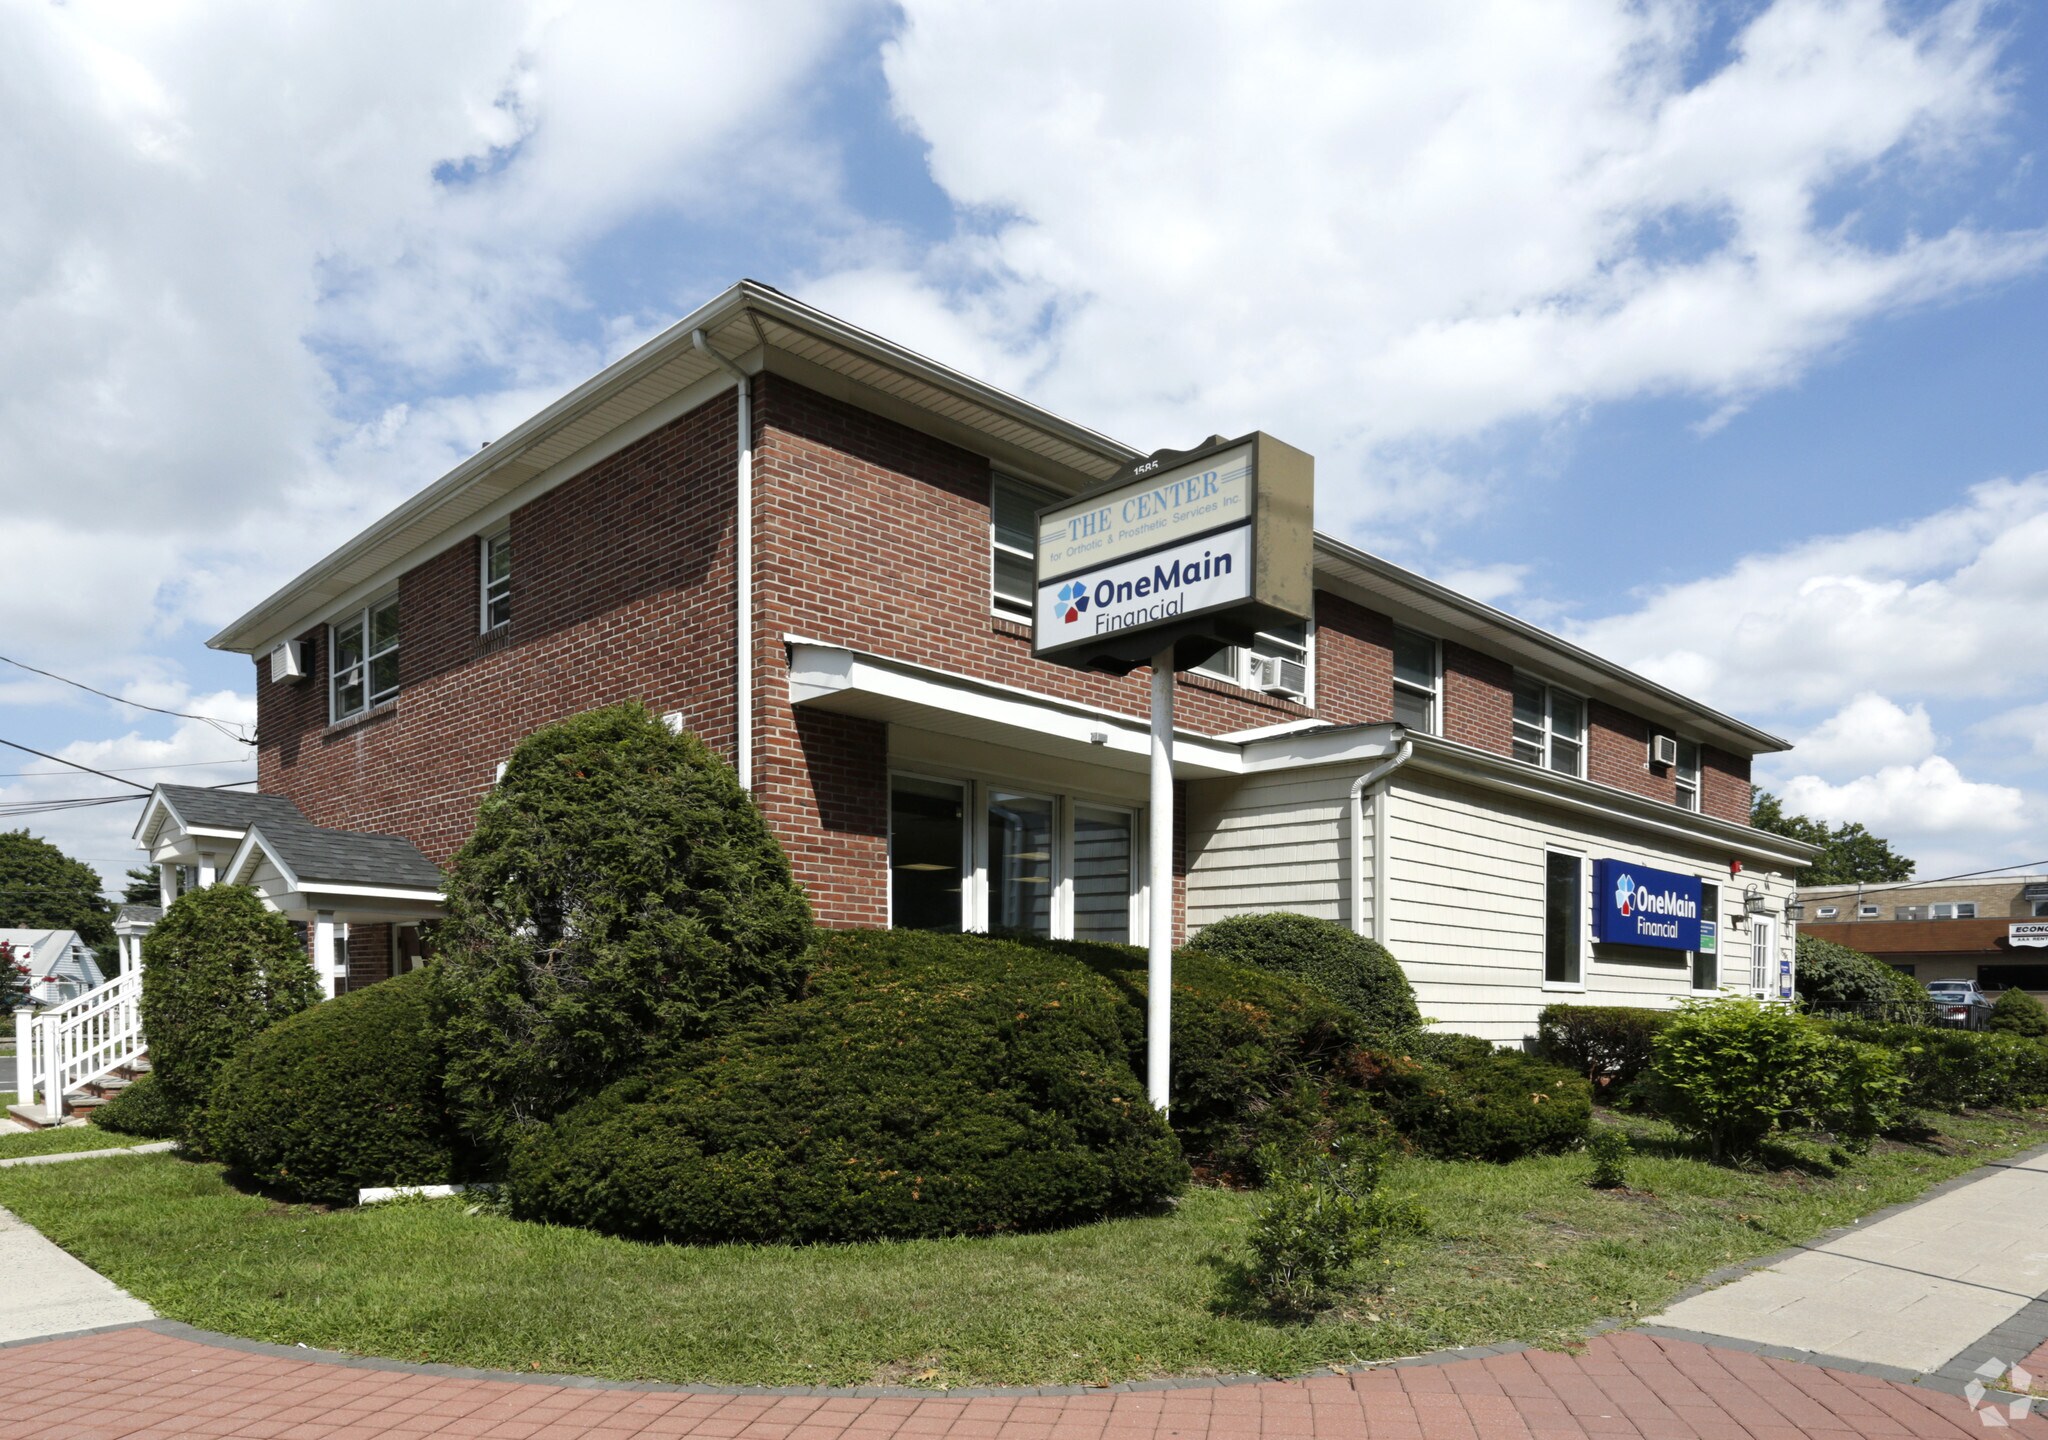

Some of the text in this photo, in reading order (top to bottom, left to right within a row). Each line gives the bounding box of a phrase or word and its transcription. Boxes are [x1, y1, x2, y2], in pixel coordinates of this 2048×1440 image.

[1133, 460, 1159, 475] 1585
[1050, 494, 1242, 562] for Orthotic & Prosthetic Services Inc.
[1068, 470, 1220, 542] THE CENTER
[1094, 550, 1232, 608] OneMain
[1095, 591, 1184, 635] Financial
[1637, 886, 1696, 918] OneMain
[1637, 916, 1678, 939] Financial
